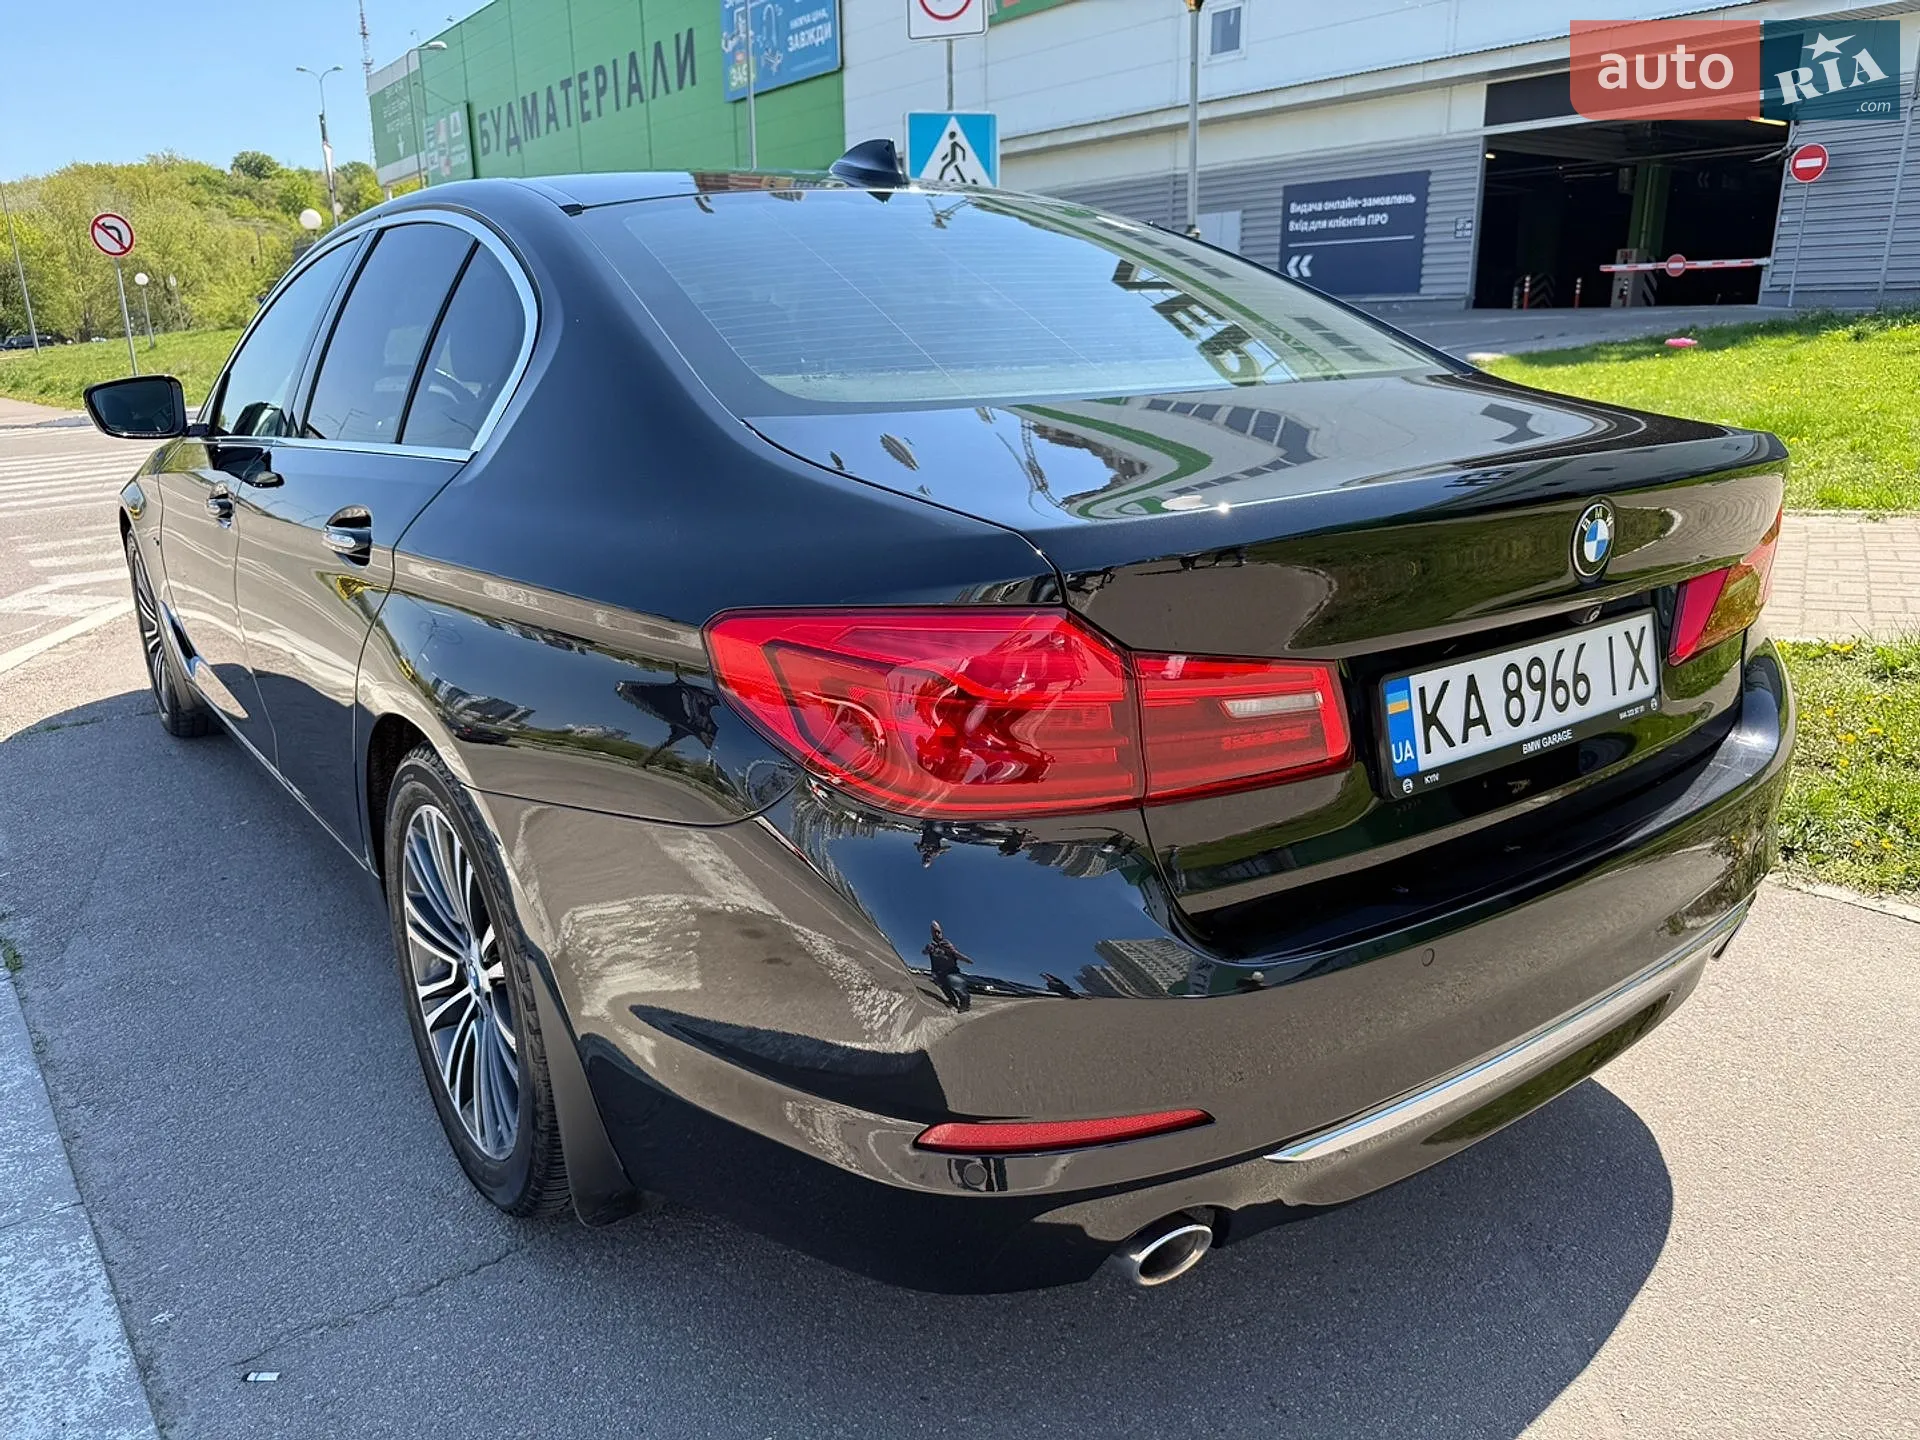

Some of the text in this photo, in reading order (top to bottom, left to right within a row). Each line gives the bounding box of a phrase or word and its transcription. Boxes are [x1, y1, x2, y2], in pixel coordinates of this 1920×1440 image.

[787, 21, 832, 51] ЗАВЖДИ
[478, 27, 697, 157] БУДМАТЕРІАЛИ
[1289, 194, 1416, 214] Видача онлайн-замовлень
[1288, 212, 1388, 232] Вхід для клієнтів ПРО
[1581, 507, 1614, 531] BMW
[1418, 625, 1650, 755] KA 8966 IX
[1392, 739, 1415, 764] UA
[1522, 728, 1573, 755] BMW GARAGE
